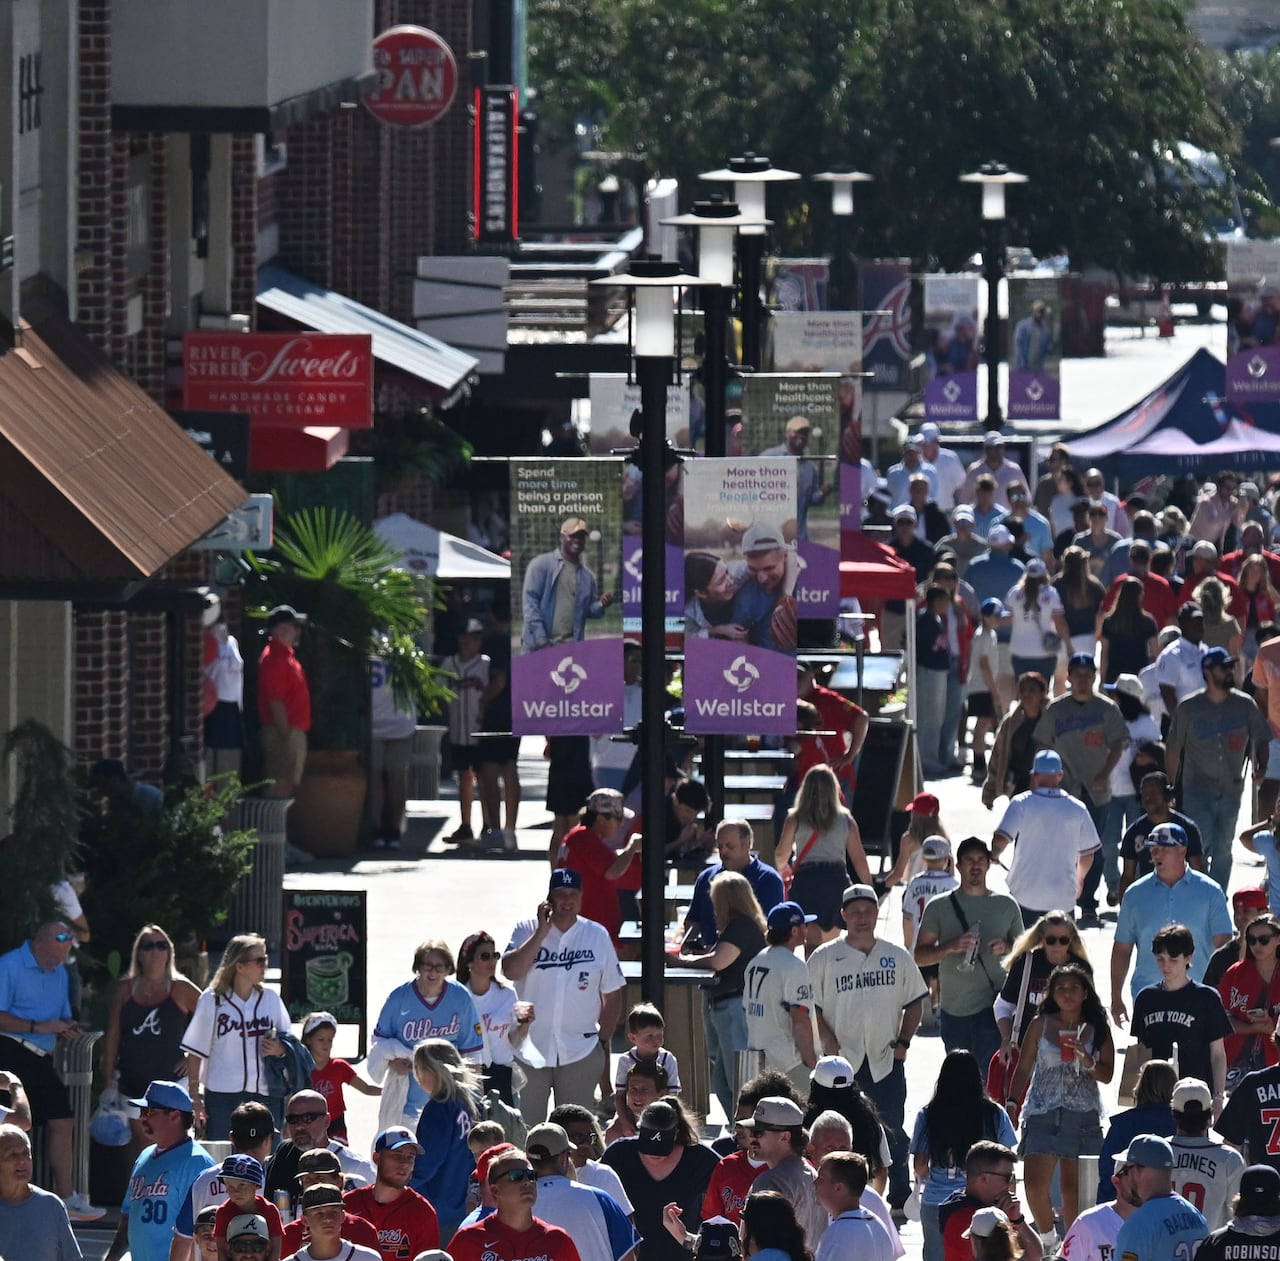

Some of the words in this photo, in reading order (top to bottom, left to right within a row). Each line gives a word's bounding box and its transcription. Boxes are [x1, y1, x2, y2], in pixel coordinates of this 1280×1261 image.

[372, 67, 444, 100] PAN
[189, 346, 241, 361] RIVER
[189, 361, 252, 377] STREET
[240, 338, 360, 384] Sweets
[208, 391, 290, 402] HANDMADE
[297, 391, 347, 404] CANDY
[276, 404, 326, 415] CREAM
[518, 467, 555, 480] Spend
[727, 466, 756, 477] More
[759, 466, 787, 477] than
[518, 481, 548, 489] more
[551, 479, 577, 489] time
[722, 478, 791, 490] healthcare.
[518, 490, 551, 502] being
[553, 493, 561, 501] a
[563, 492, 604, 503] person
[719, 491, 791, 503] PeopleCare.
[518, 503, 545, 513] than
[548, 505, 556, 513] a
[558, 502, 605, 515] patient.
[523, 700, 614, 719] Wellstar
[695, 698, 787, 717] Wellstar
[533, 946, 596, 970] Dodgers
[879, 956, 896, 969] 05
[748, 965, 771, 1000] 17
[836, 976, 854, 994] LOS
[856, 969, 896, 992] ANGELES
[132, 1008, 162, 1036] A
[402, 1014, 461, 1042] Atlanta
[1144, 1010, 1166, 1026] NEW
[1167, 1010, 1196, 1028] YORK
[1172, 1152, 1218, 1180] JONES
[141, 1199, 169, 1225] 30
[243, 1218, 257, 1230] A
[1163, 1210, 1204, 1236] BALDW
